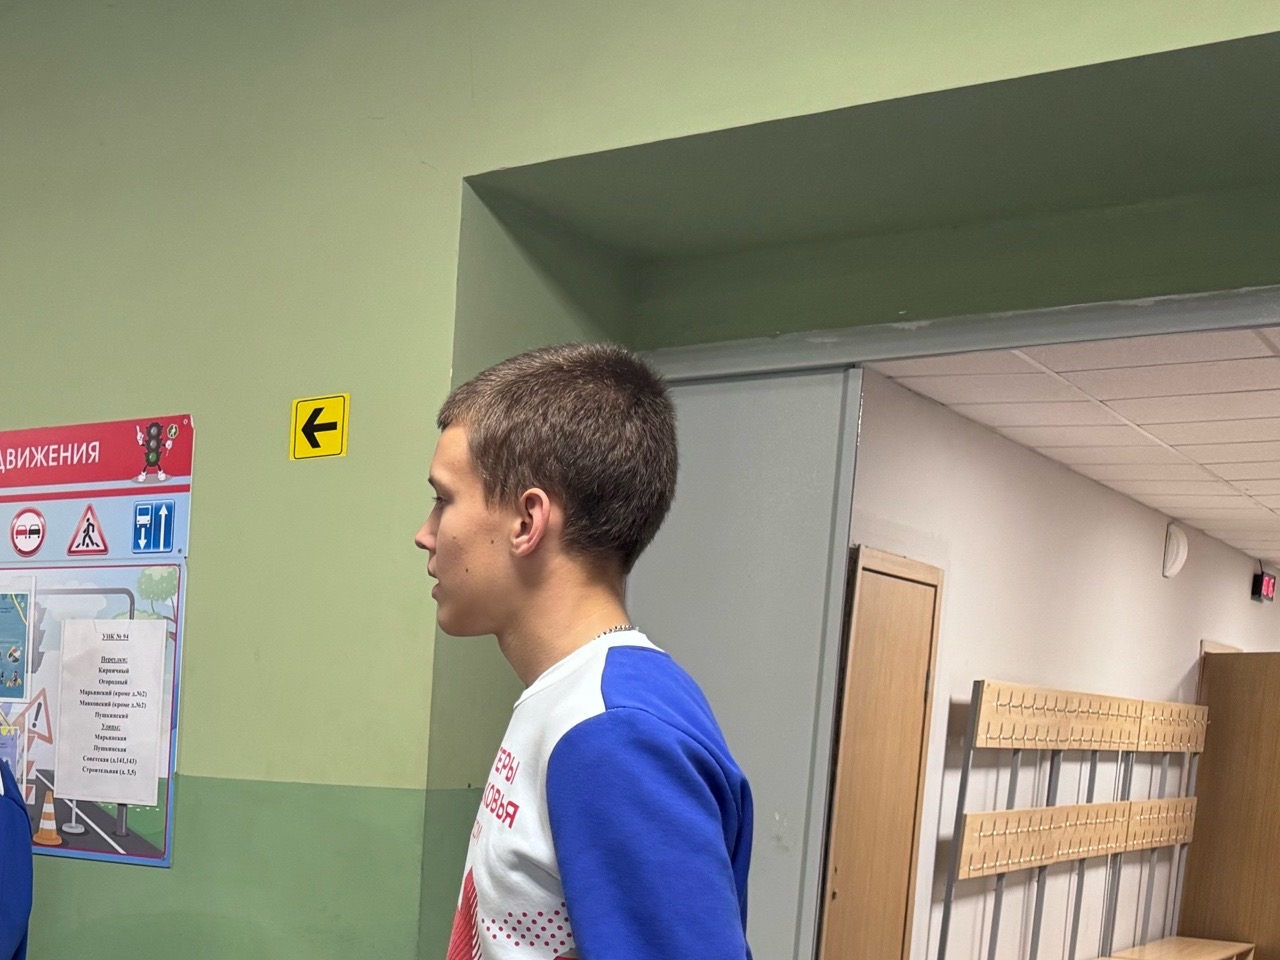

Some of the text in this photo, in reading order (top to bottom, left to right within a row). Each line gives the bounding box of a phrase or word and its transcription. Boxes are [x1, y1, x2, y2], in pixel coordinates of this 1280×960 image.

[98, 667, 130, 675] Кирпичный
[98, 678, 128, 686] Огородный
[112, 689, 131, 698] (кроме
[112, 700, 130, 709] (кроме
[94, 712, 129, 720] Пушкинский
[93, 745, 127, 753] Пушкинская
[82, 755, 109, 763] Советская
[82, 766, 118, 775] Строительная
